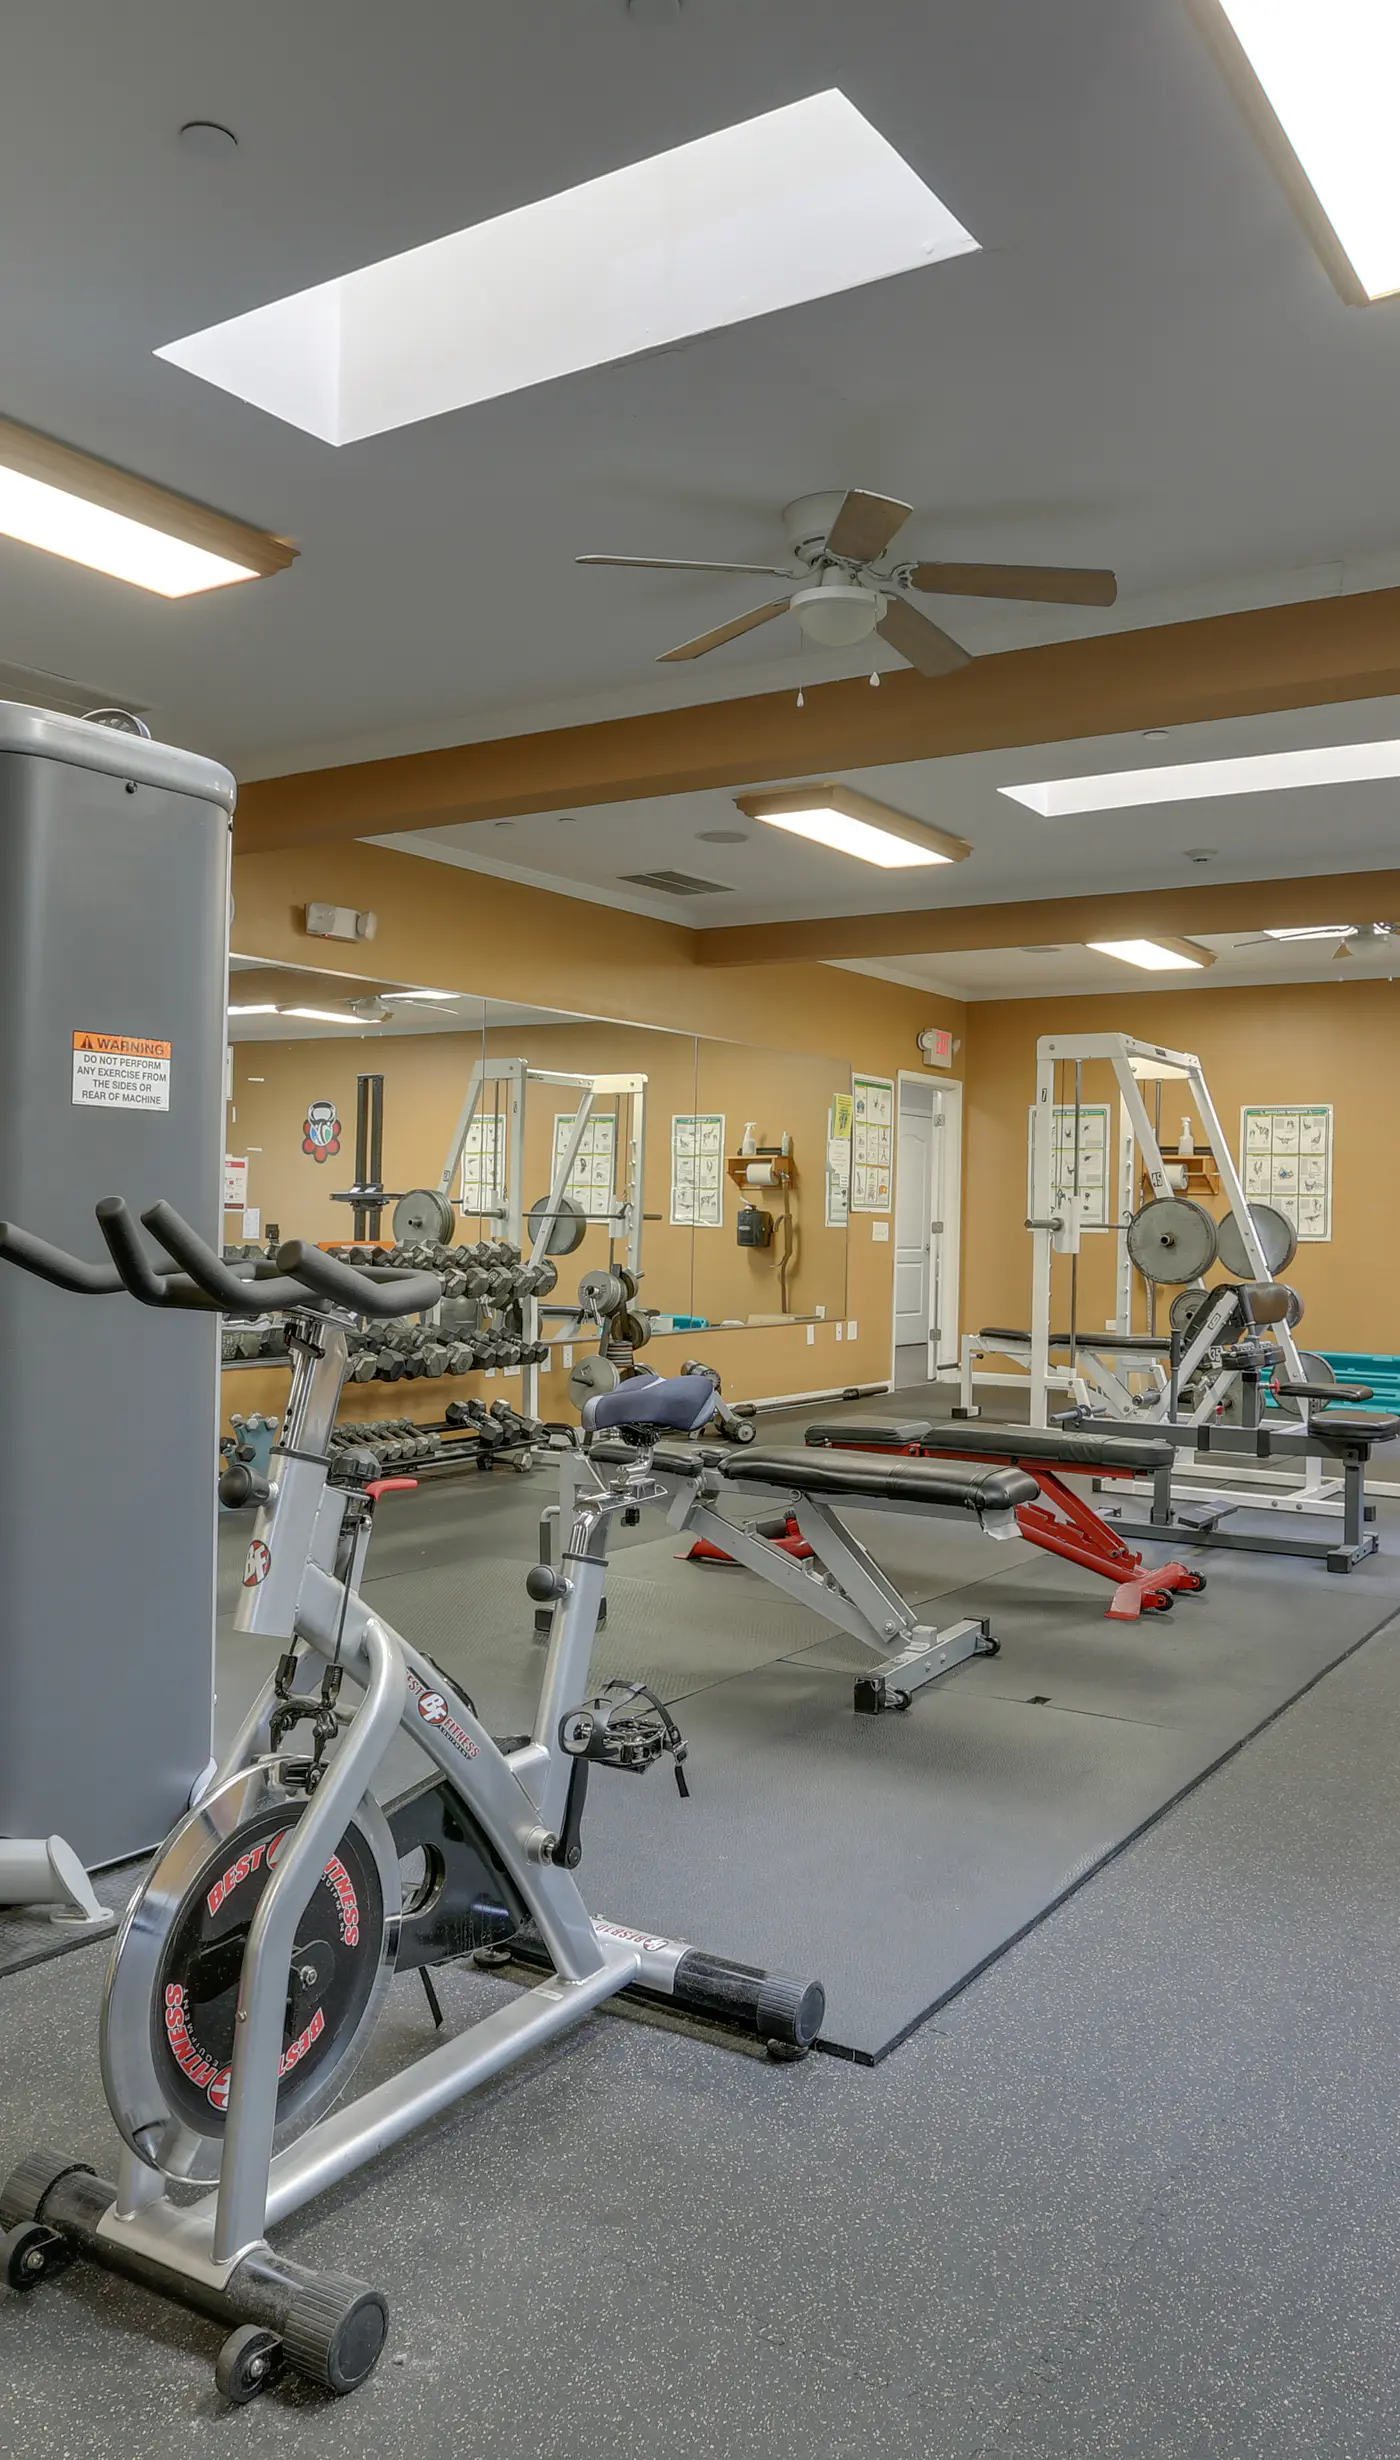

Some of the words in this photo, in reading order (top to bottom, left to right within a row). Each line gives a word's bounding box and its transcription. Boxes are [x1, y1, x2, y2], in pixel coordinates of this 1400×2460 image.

[84, 1054, 97, 1064] DO
[99, 1056, 118, 1066] NOT
[120, 1058, 162, 1070] PERFORM
[97, 1037, 164, 1055] WARNING
[77, 1066, 96, 1076] ANY
[98, 1068, 140, 1080] EXERCISE
[142, 1072, 167, 1082] FROM
[93, 1079, 110, 1089] THE
[112, 1080, 137, 1091] SIDES
[139, 1083, 152, 1092] OR
[82, 1090, 106, 1100] REAR
[108, 1092, 120, 1101] OF
[122, 1093, 161, 1105] MACHINE
[419, 1692, 448, 1722] BF
[443, 1716, 480, 1758] FITNESS
[206, 1844, 267, 1917] BEST
[321, 1853, 359, 1947] ITNESS
[320, 1873, 345, 1943] QUIPMENT
[595, 1924, 647, 1943] BFSB10
[165, 1983, 218, 2089] FITNESS
[183, 1987, 219, 2067] EQUIPMENT
